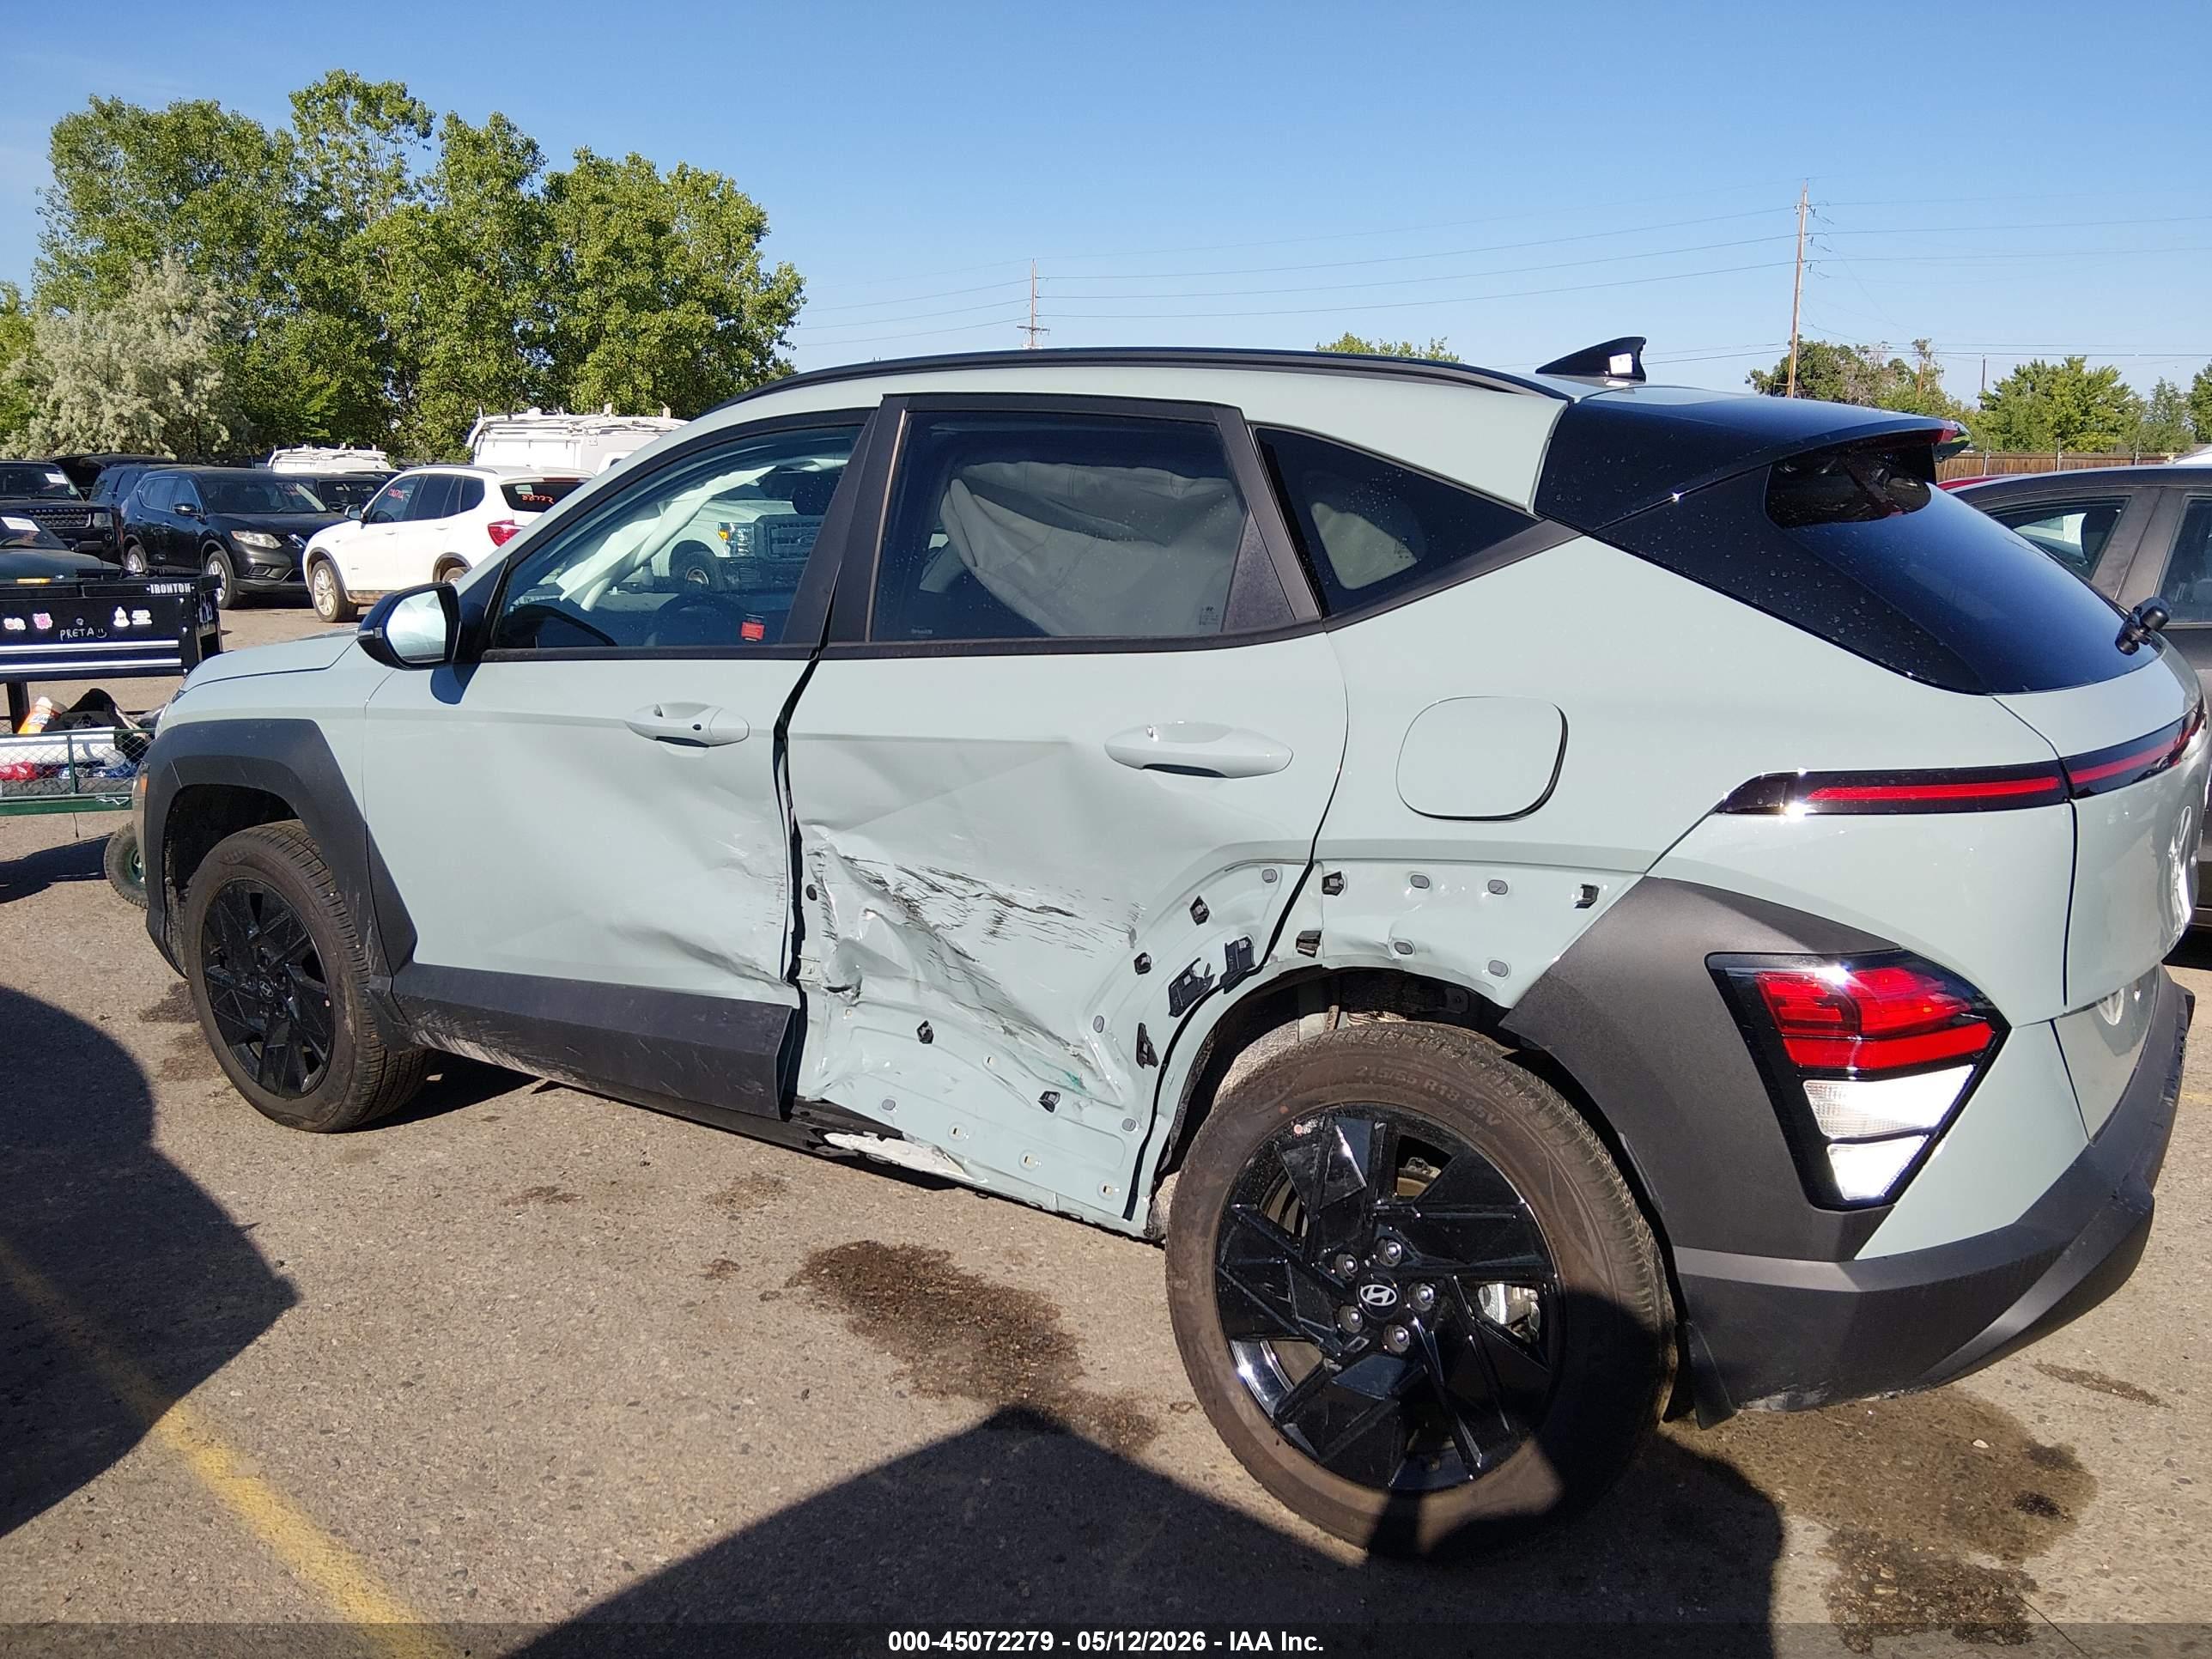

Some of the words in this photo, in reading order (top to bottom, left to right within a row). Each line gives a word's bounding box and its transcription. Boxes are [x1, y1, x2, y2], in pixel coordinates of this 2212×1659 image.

[150, 583, 191, 594] IRONTON
[60, 628, 94, 641] PRETA
[1354, 1065, 1418, 1085] 215/55
[1423, 1078, 1460, 1102] R18
[1462, 1097, 1503, 1127] 95V
